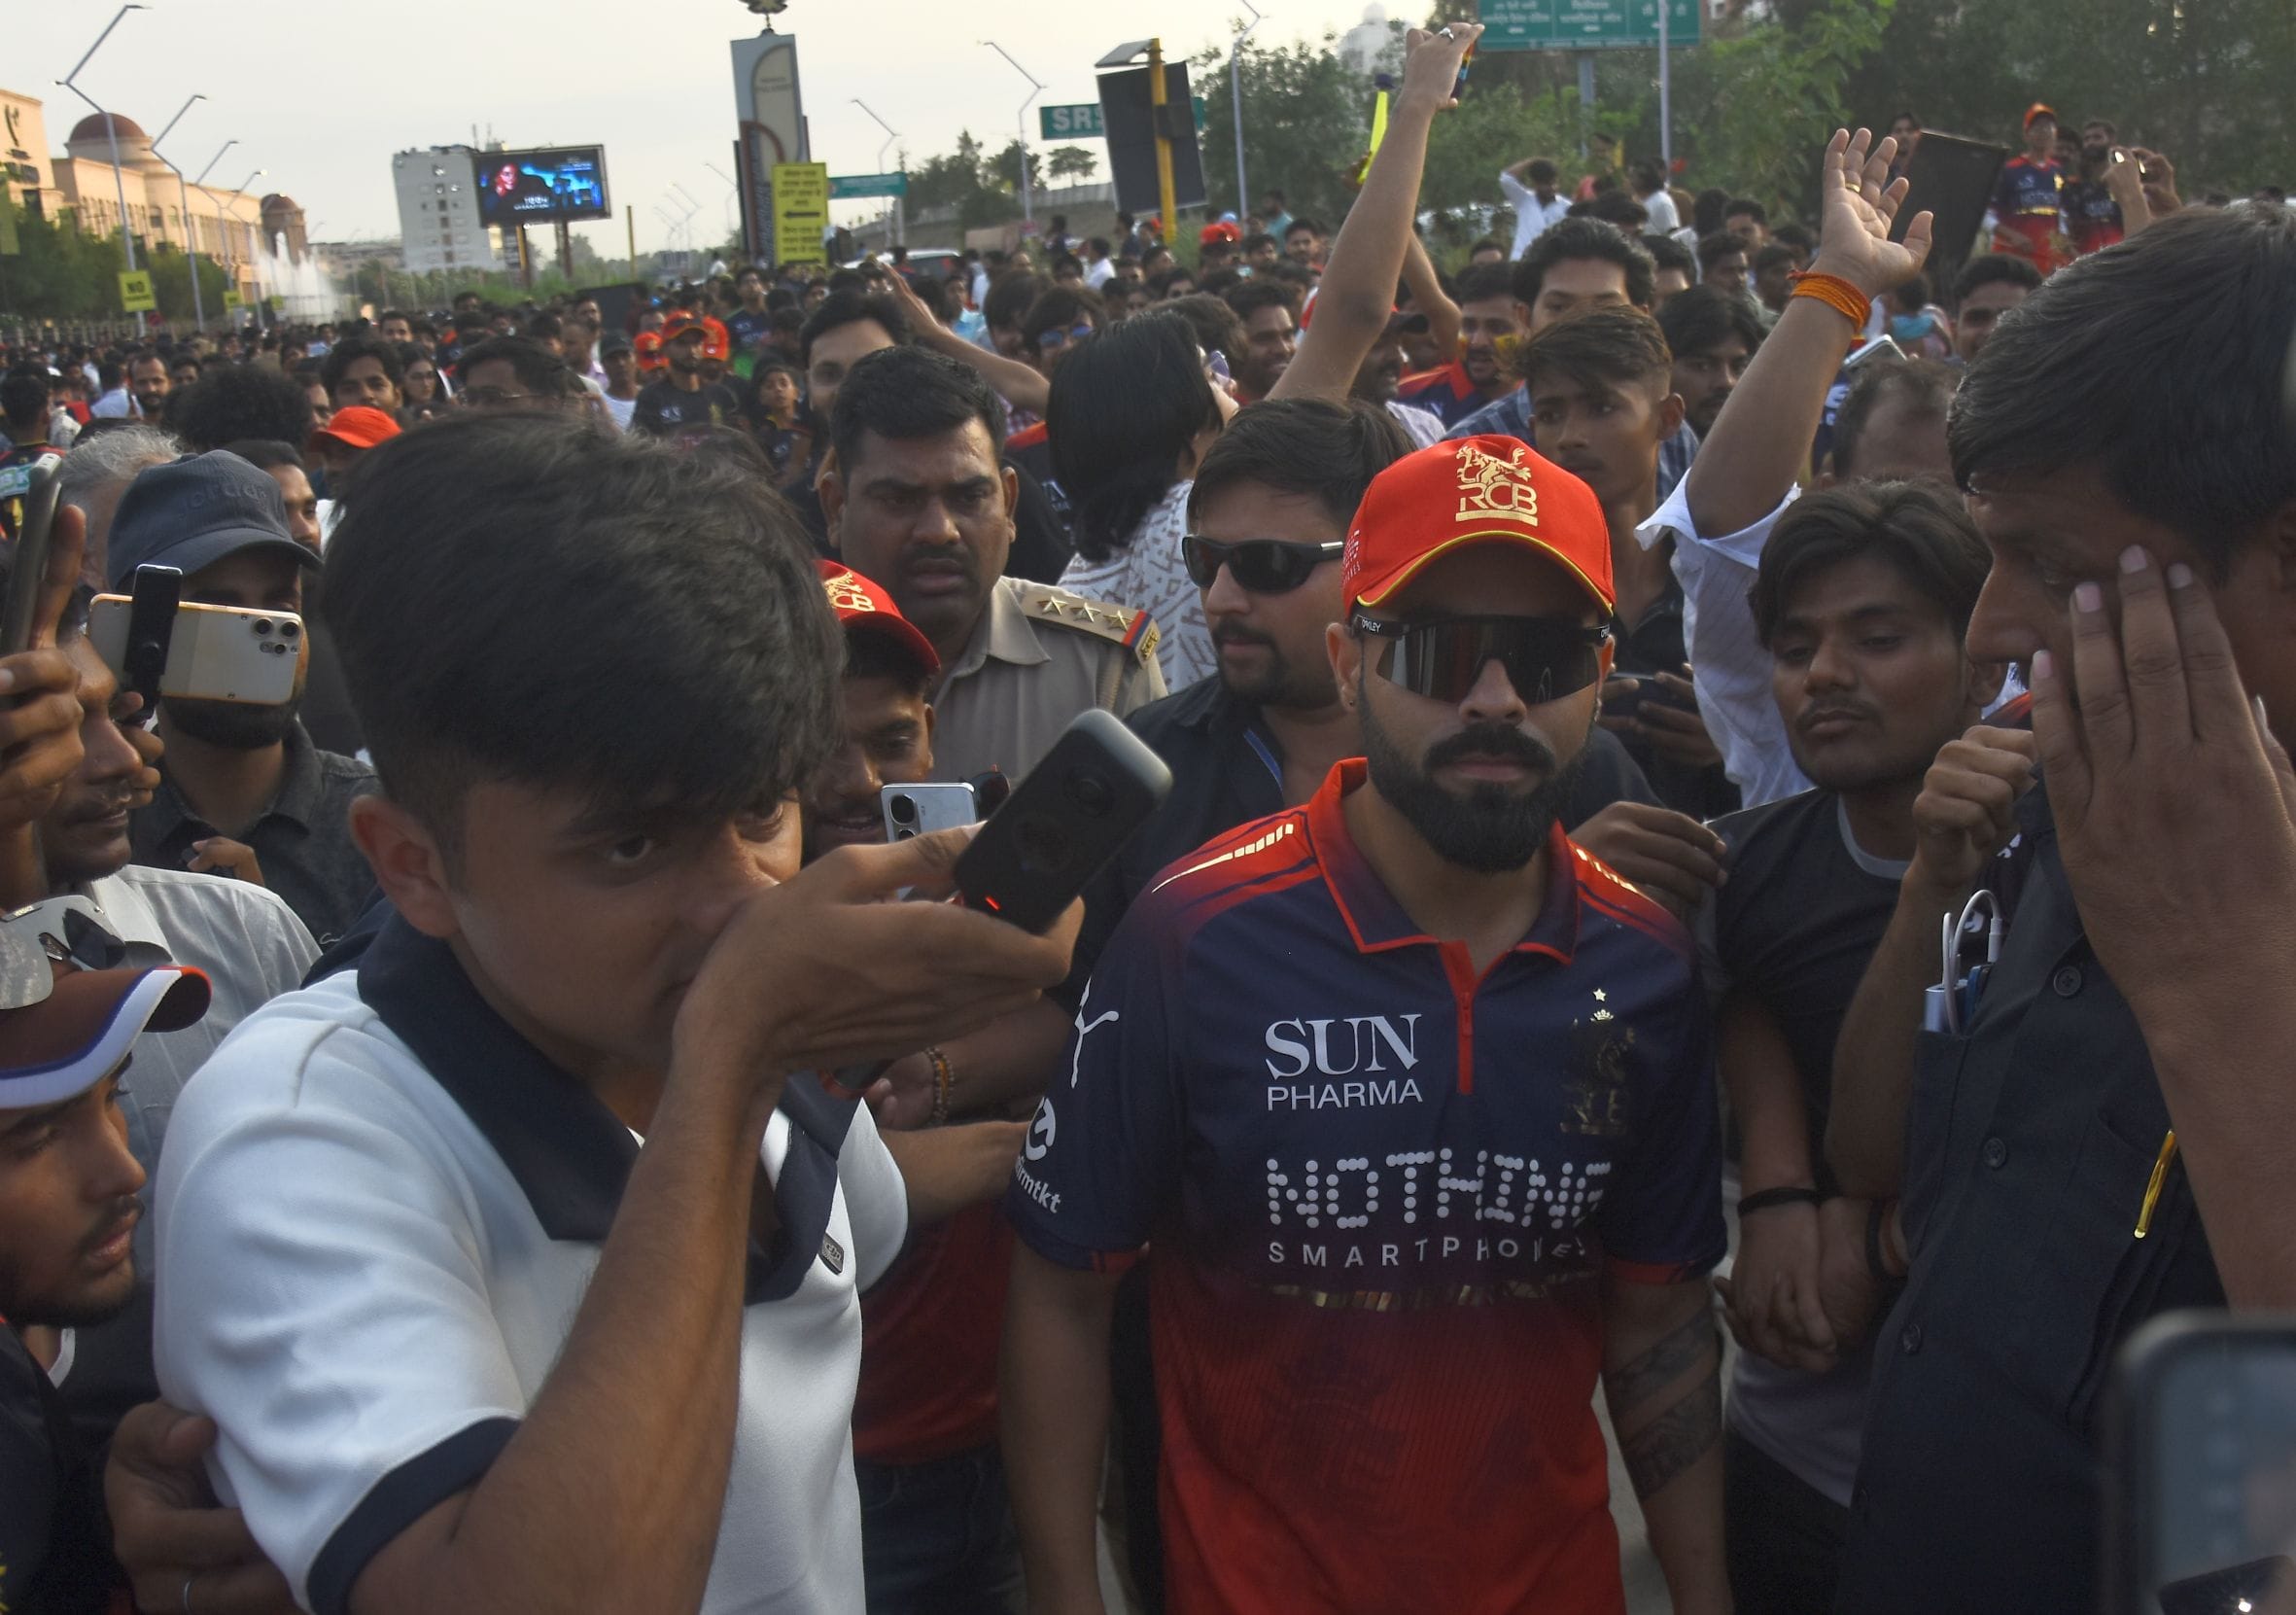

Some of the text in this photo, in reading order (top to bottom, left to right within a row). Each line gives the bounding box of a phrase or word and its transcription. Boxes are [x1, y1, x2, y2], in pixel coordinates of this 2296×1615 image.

[1456, 480, 1538, 515] RCB
[831, 594, 876, 613] CB
[1266, 1013, 1422, 1080] SUN
[1268, 1079, 1423, 1111] PHARMA
